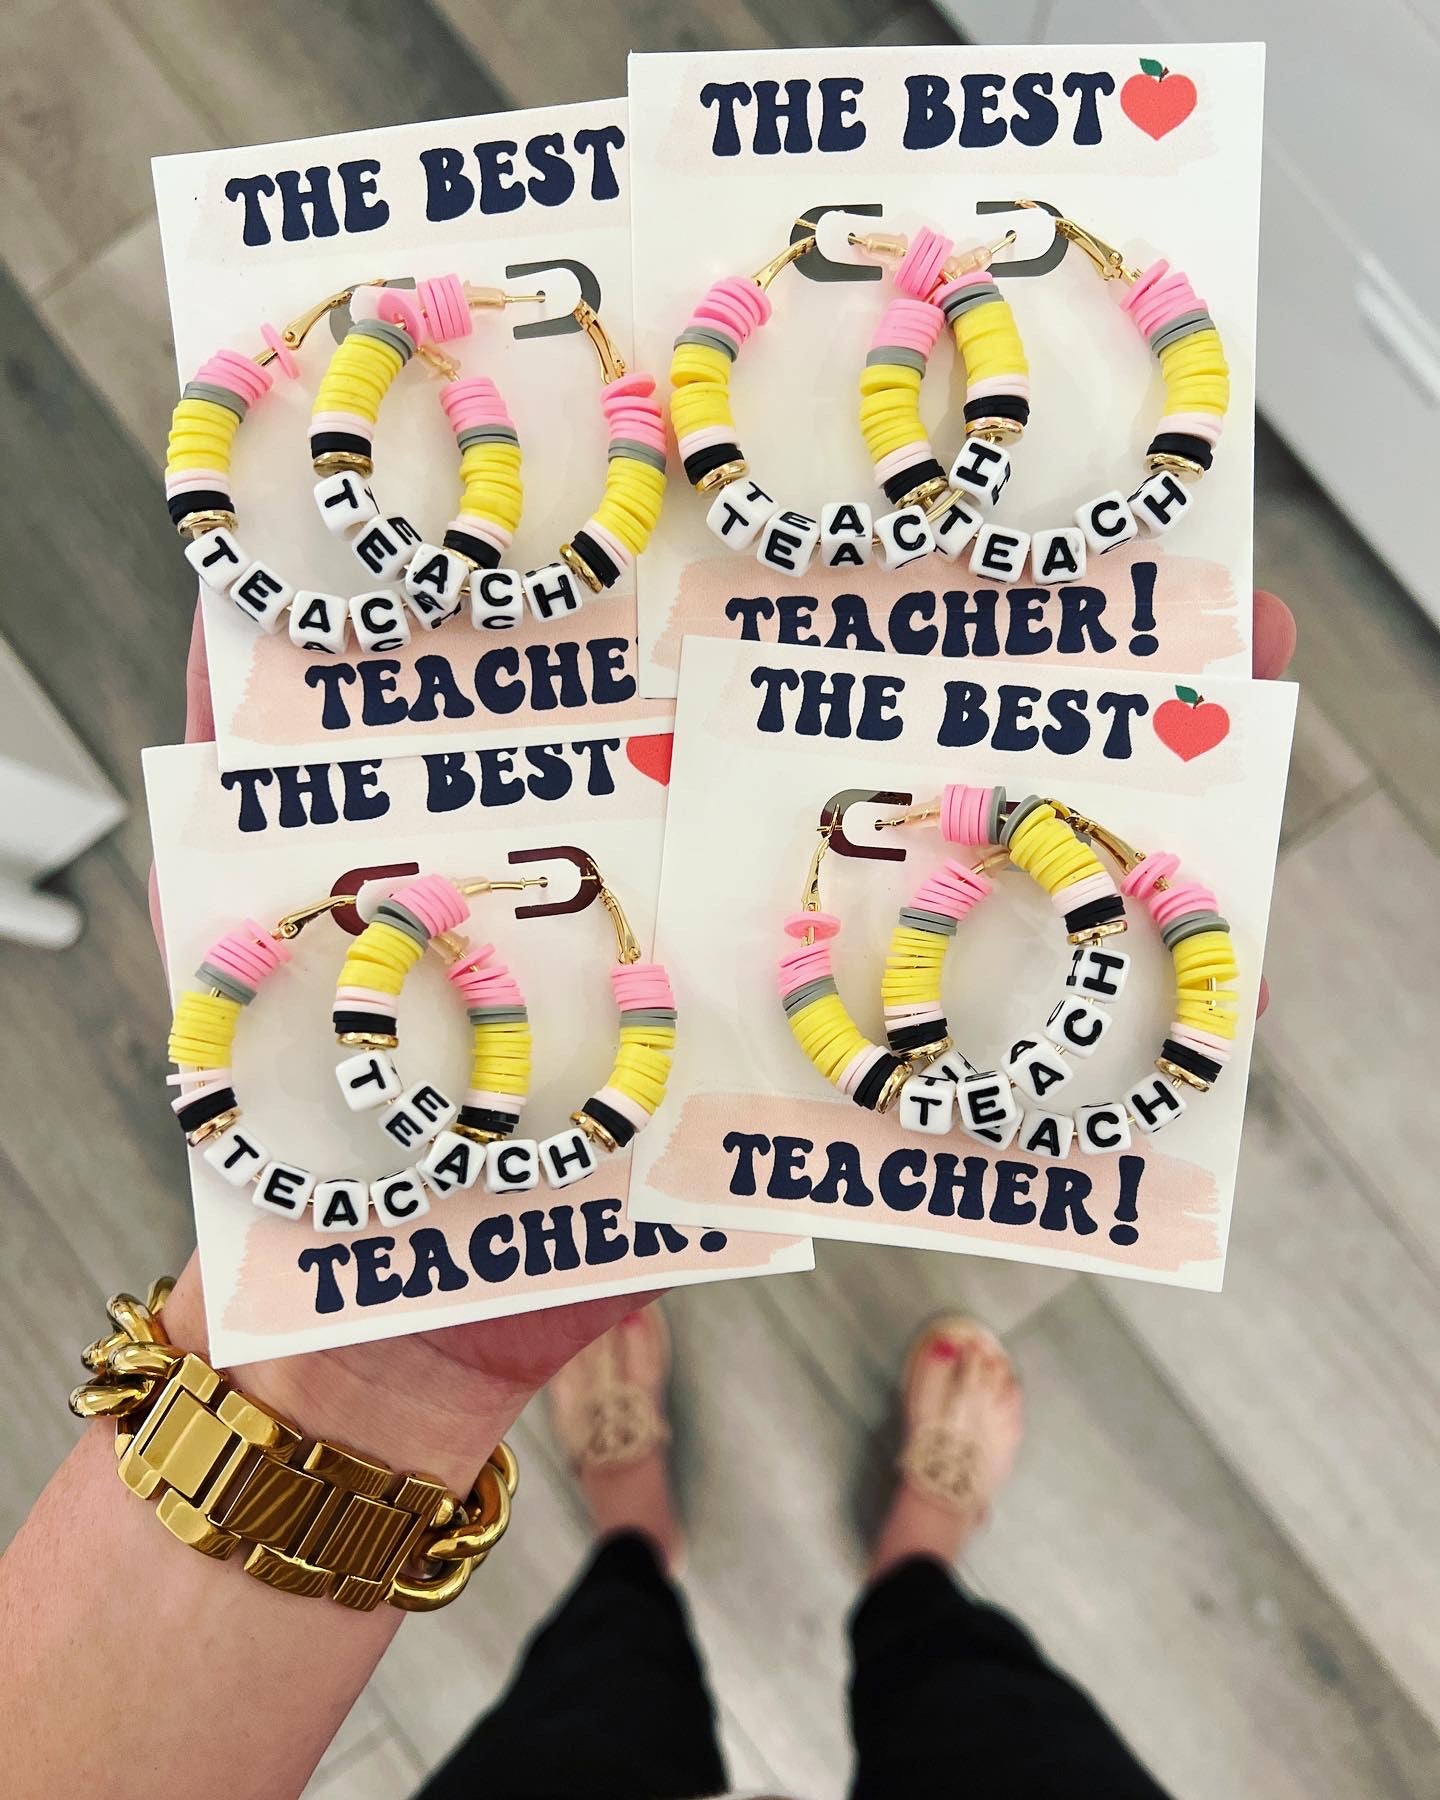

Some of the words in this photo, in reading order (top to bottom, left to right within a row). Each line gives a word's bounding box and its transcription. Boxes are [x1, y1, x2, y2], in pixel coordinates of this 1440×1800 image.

[700, 78, 866, 156] THE
[903, 72, 1115, 150] BEST
[225, 159, 389, 246] THE
[420, 126, 625, 222] BEST
[324, 478, 582, 617] TEACH
[725, 562, 1159, 657] TEACHER!
[302, 637, 636, 729] TEACHE
[751, 667, 905, 741] THE
[937, 681, 1149, 759] BEST
[221, 759, 390, 832] THE
[421, 738, 620, 812] BEST
[350, 1059, 590, 1185] TEACH
[223, 1135, 450, 1227] TEAC
[722, 1131, 1145, 1245] TEACHER!
